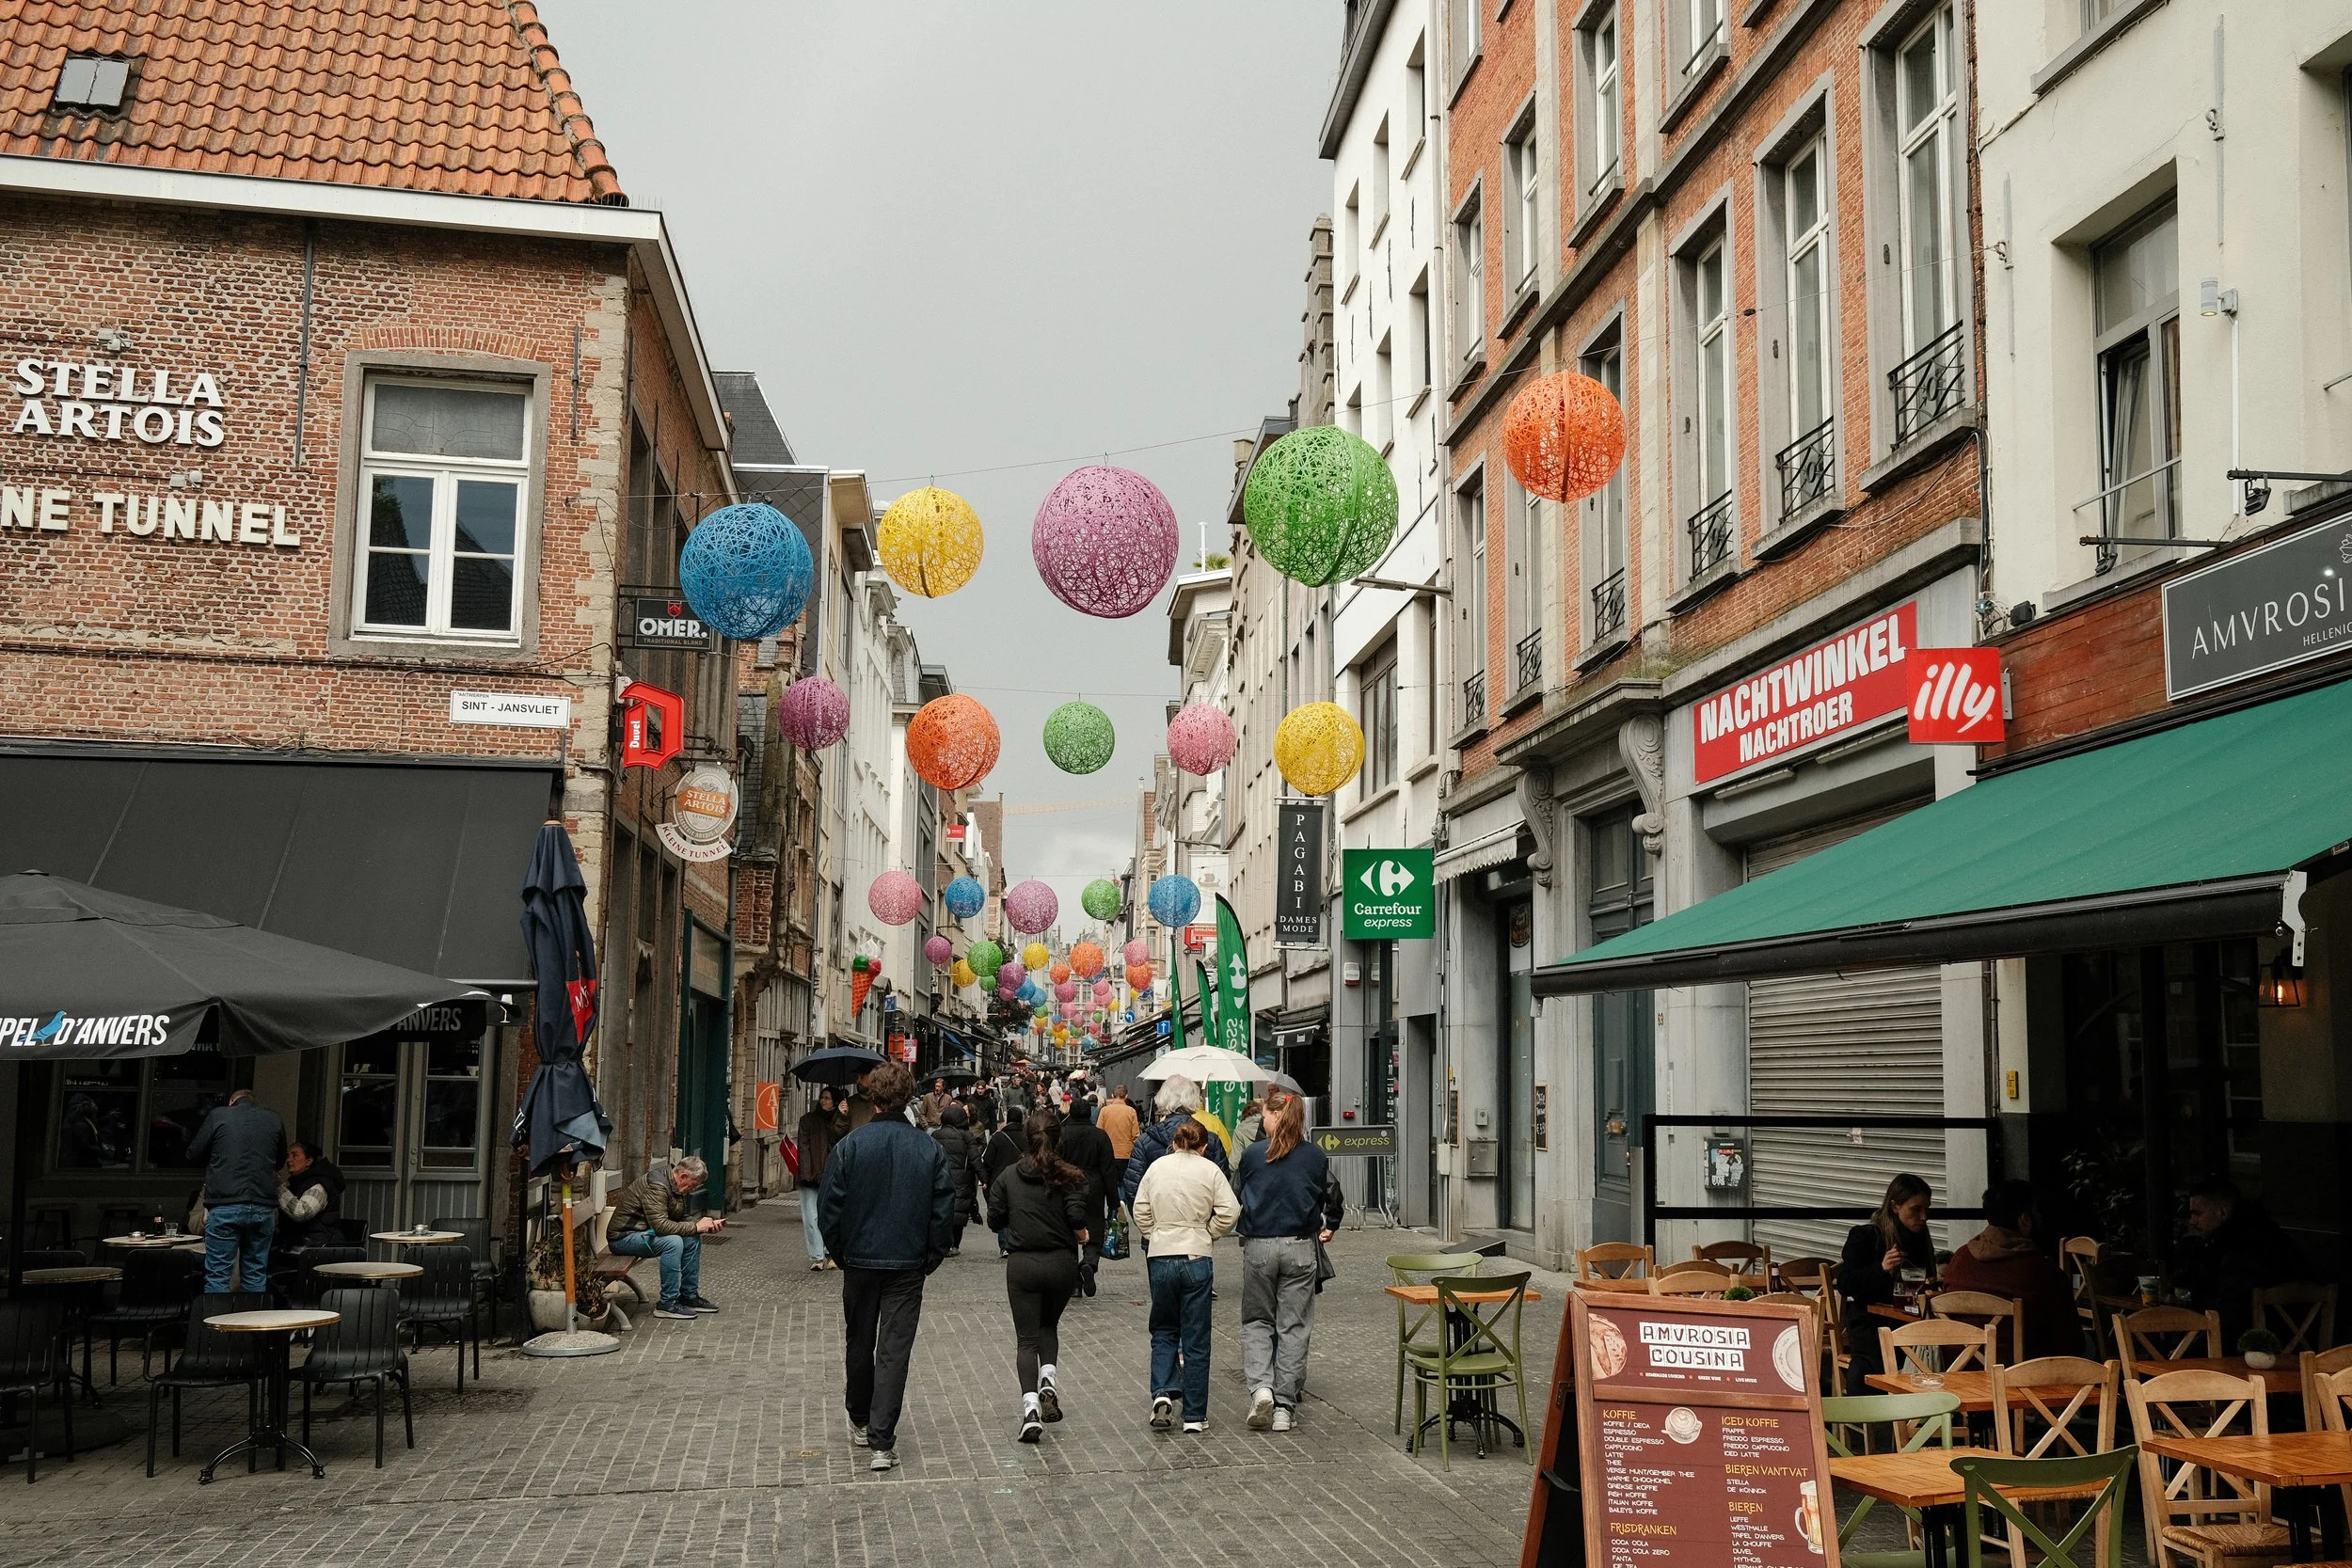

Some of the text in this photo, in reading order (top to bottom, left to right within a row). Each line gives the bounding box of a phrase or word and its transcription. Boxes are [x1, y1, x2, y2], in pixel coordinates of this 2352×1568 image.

[16, 358, 226, 407] STELLA
[12, 399, 225, 447] ARTOIS
[93, 492, 301, 546] TUNNEL
[2192, 578, 2344, 659] AMVROSI
[1700, 613, 1907, 744] NACHTWINKEL
[1914, 661, 1995, 734] illy
[462, 701, 487, 710] SINT
[498, 703, 560, 715] JANSVLIET
[629, 721, 641, 749] Duvel
[1740, 690, 1853, 764] NACHTROER
[684, 799, 725, 814] ARTOIS
[686, 789, 726, 806] STELLA
[662, 826, 688, 855] KLEINE
[689, 844, 728, 858] TUNNEL
[1294, 814, 1306, 909] PAGABI
[1354, 902, 1422, 915] Carrefour
[1280, 915, 1317, 924] DAMES
[1364, 918, 1412, 929] express
[1282, 925, 1314, 933] MODE
[0, 1015, 170, 1046] PEL D'ANVERS
[1344, 1136, 1390, 1148] express
[1643, 1325, 1748, 1345] AMVROSIA
[1651, 1348, 1741, 1367] COUSINA
[1603, 1409, 1637, 1420] KOFFIE
[1721, 1417, 1779, 1428] ICED KOFFIE
[1725, 1464, 1759, 1476] BIEREN
[1788, 1467, 1808, 1477] VAT
[1728, 1502, 1763, 1514] BIEREN
[1611, 1522, 1677, 1536] FRISDRANKEN
